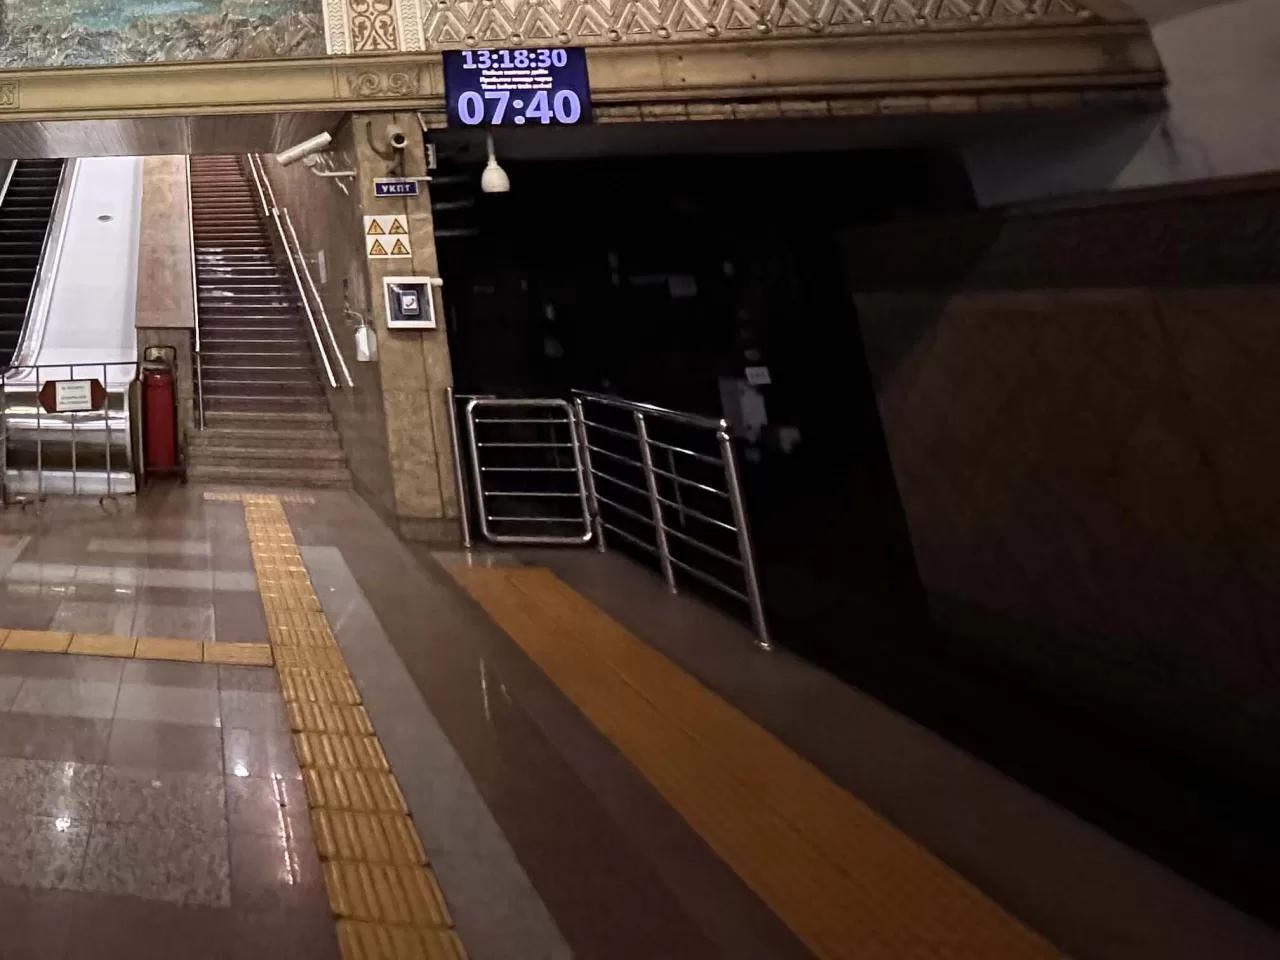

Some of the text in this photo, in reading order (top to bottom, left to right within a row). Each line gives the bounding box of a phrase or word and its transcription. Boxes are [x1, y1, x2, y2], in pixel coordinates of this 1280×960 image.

[462, 49, 568, 69] 13:18:30
[457, 90, 581, 125] 07:40
[381, 184, 411, 193] УКПТ
